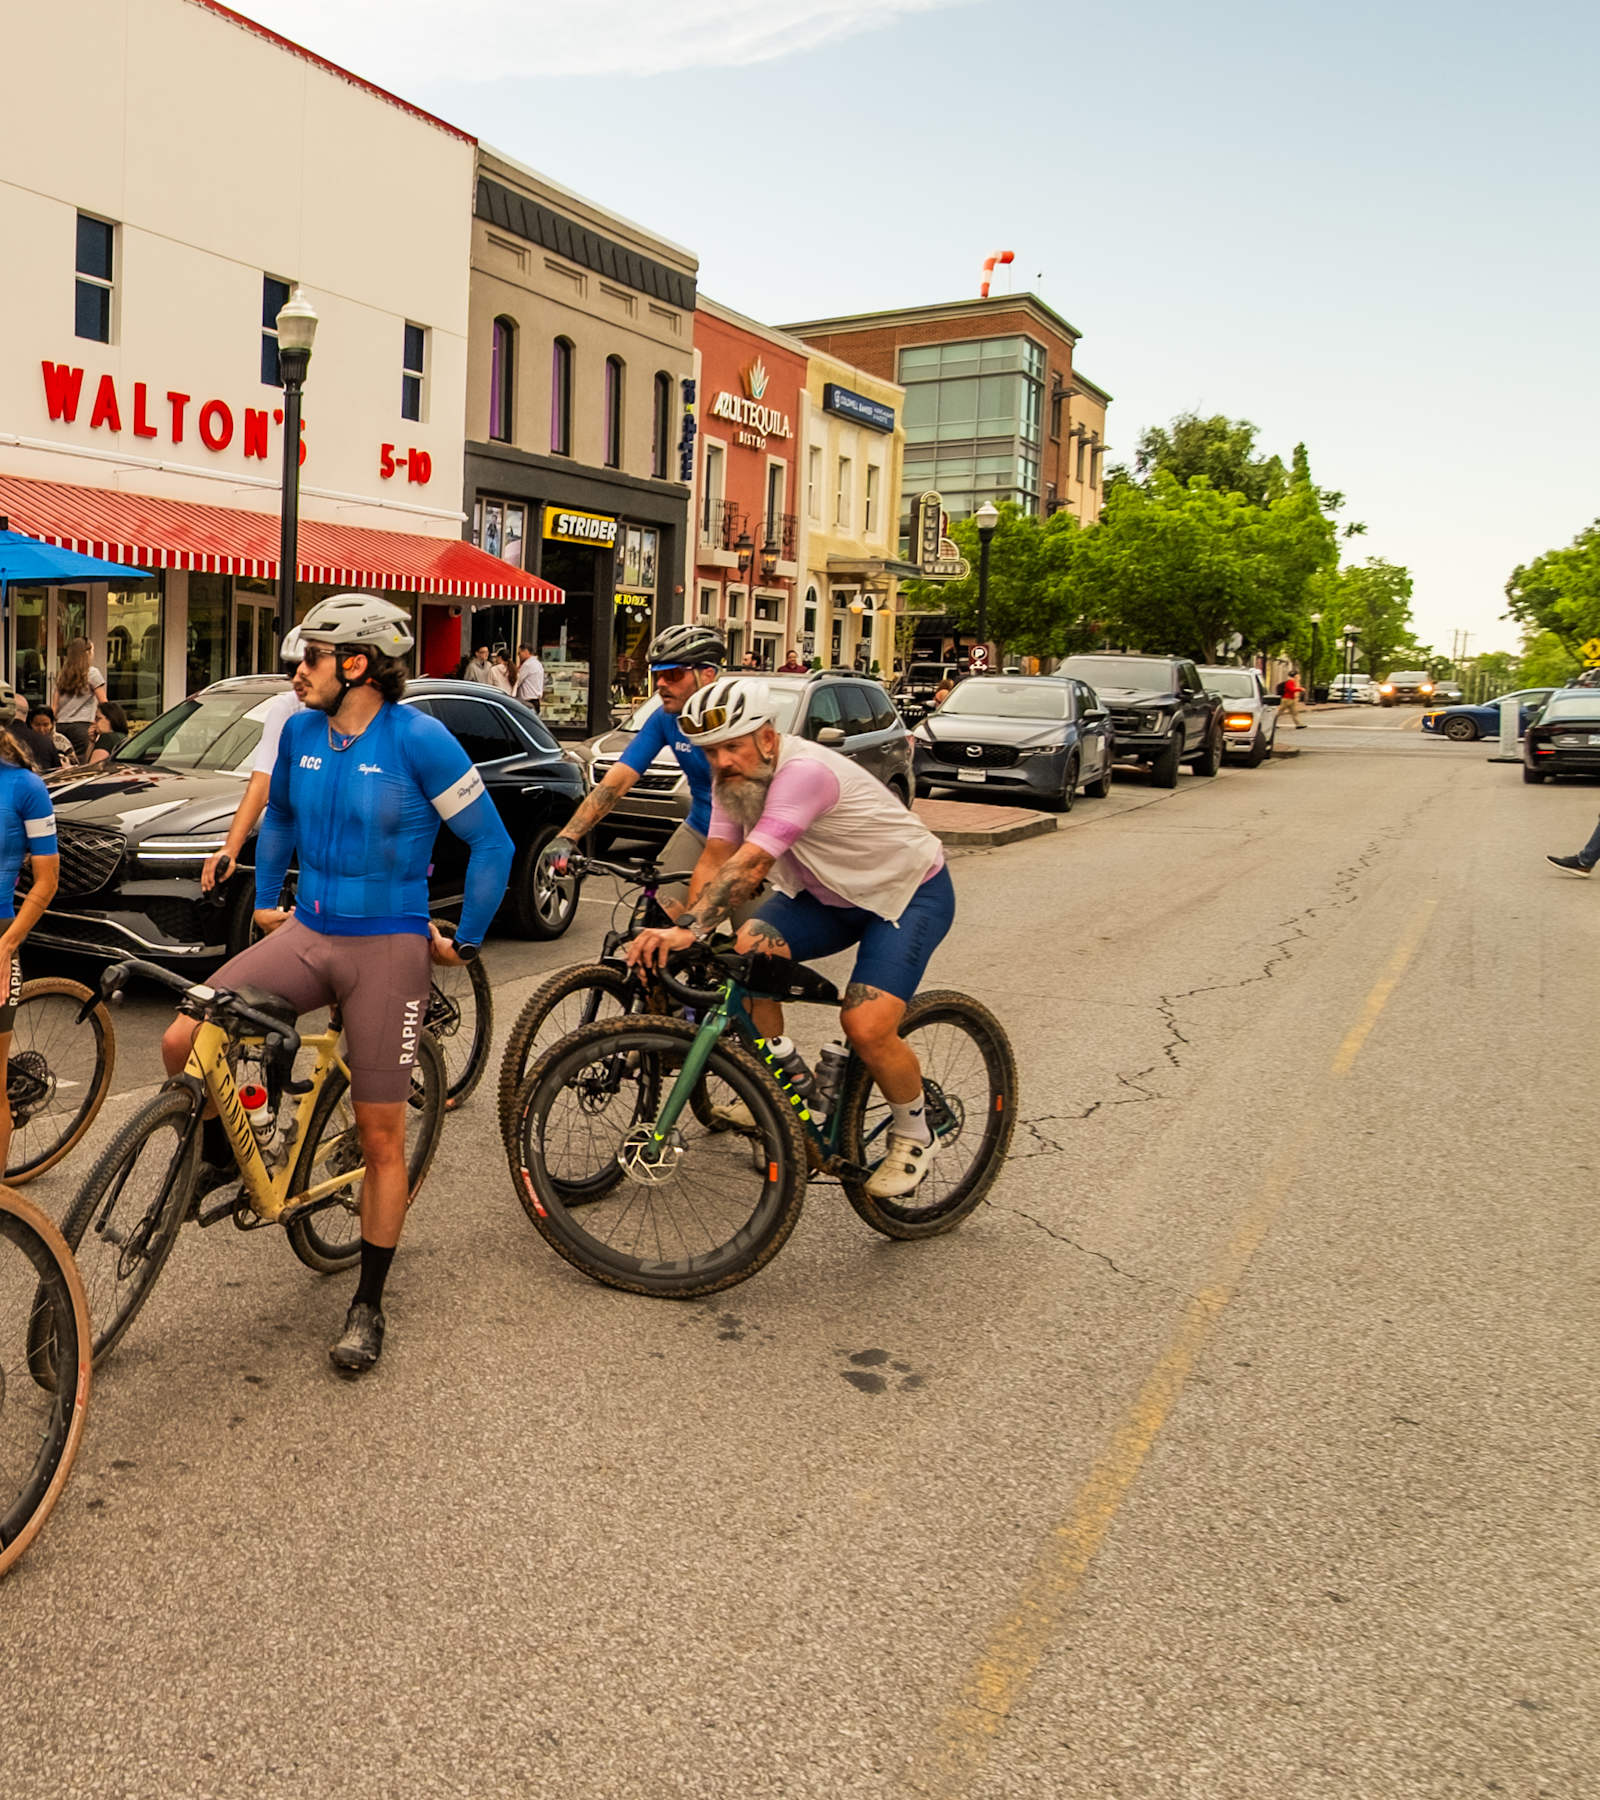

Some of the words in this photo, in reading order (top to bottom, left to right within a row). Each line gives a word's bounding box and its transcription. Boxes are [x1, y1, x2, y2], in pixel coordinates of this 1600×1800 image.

[42, 361, 306, 466] WALTON'
[379, 443, 432, 486] 5-10
[739, 430, 767, 450] BISTRO
[557, 513, 618, 541] STRIDER
[299, 755, 323, 771] RCC
[8, 958, 21, 1007] RAPHA
[399, 1000, 420, 1065] RAPHA
[753, 1038, 810, 1121] ALLIED
[218, 1073, 256, 1164] CANYON
